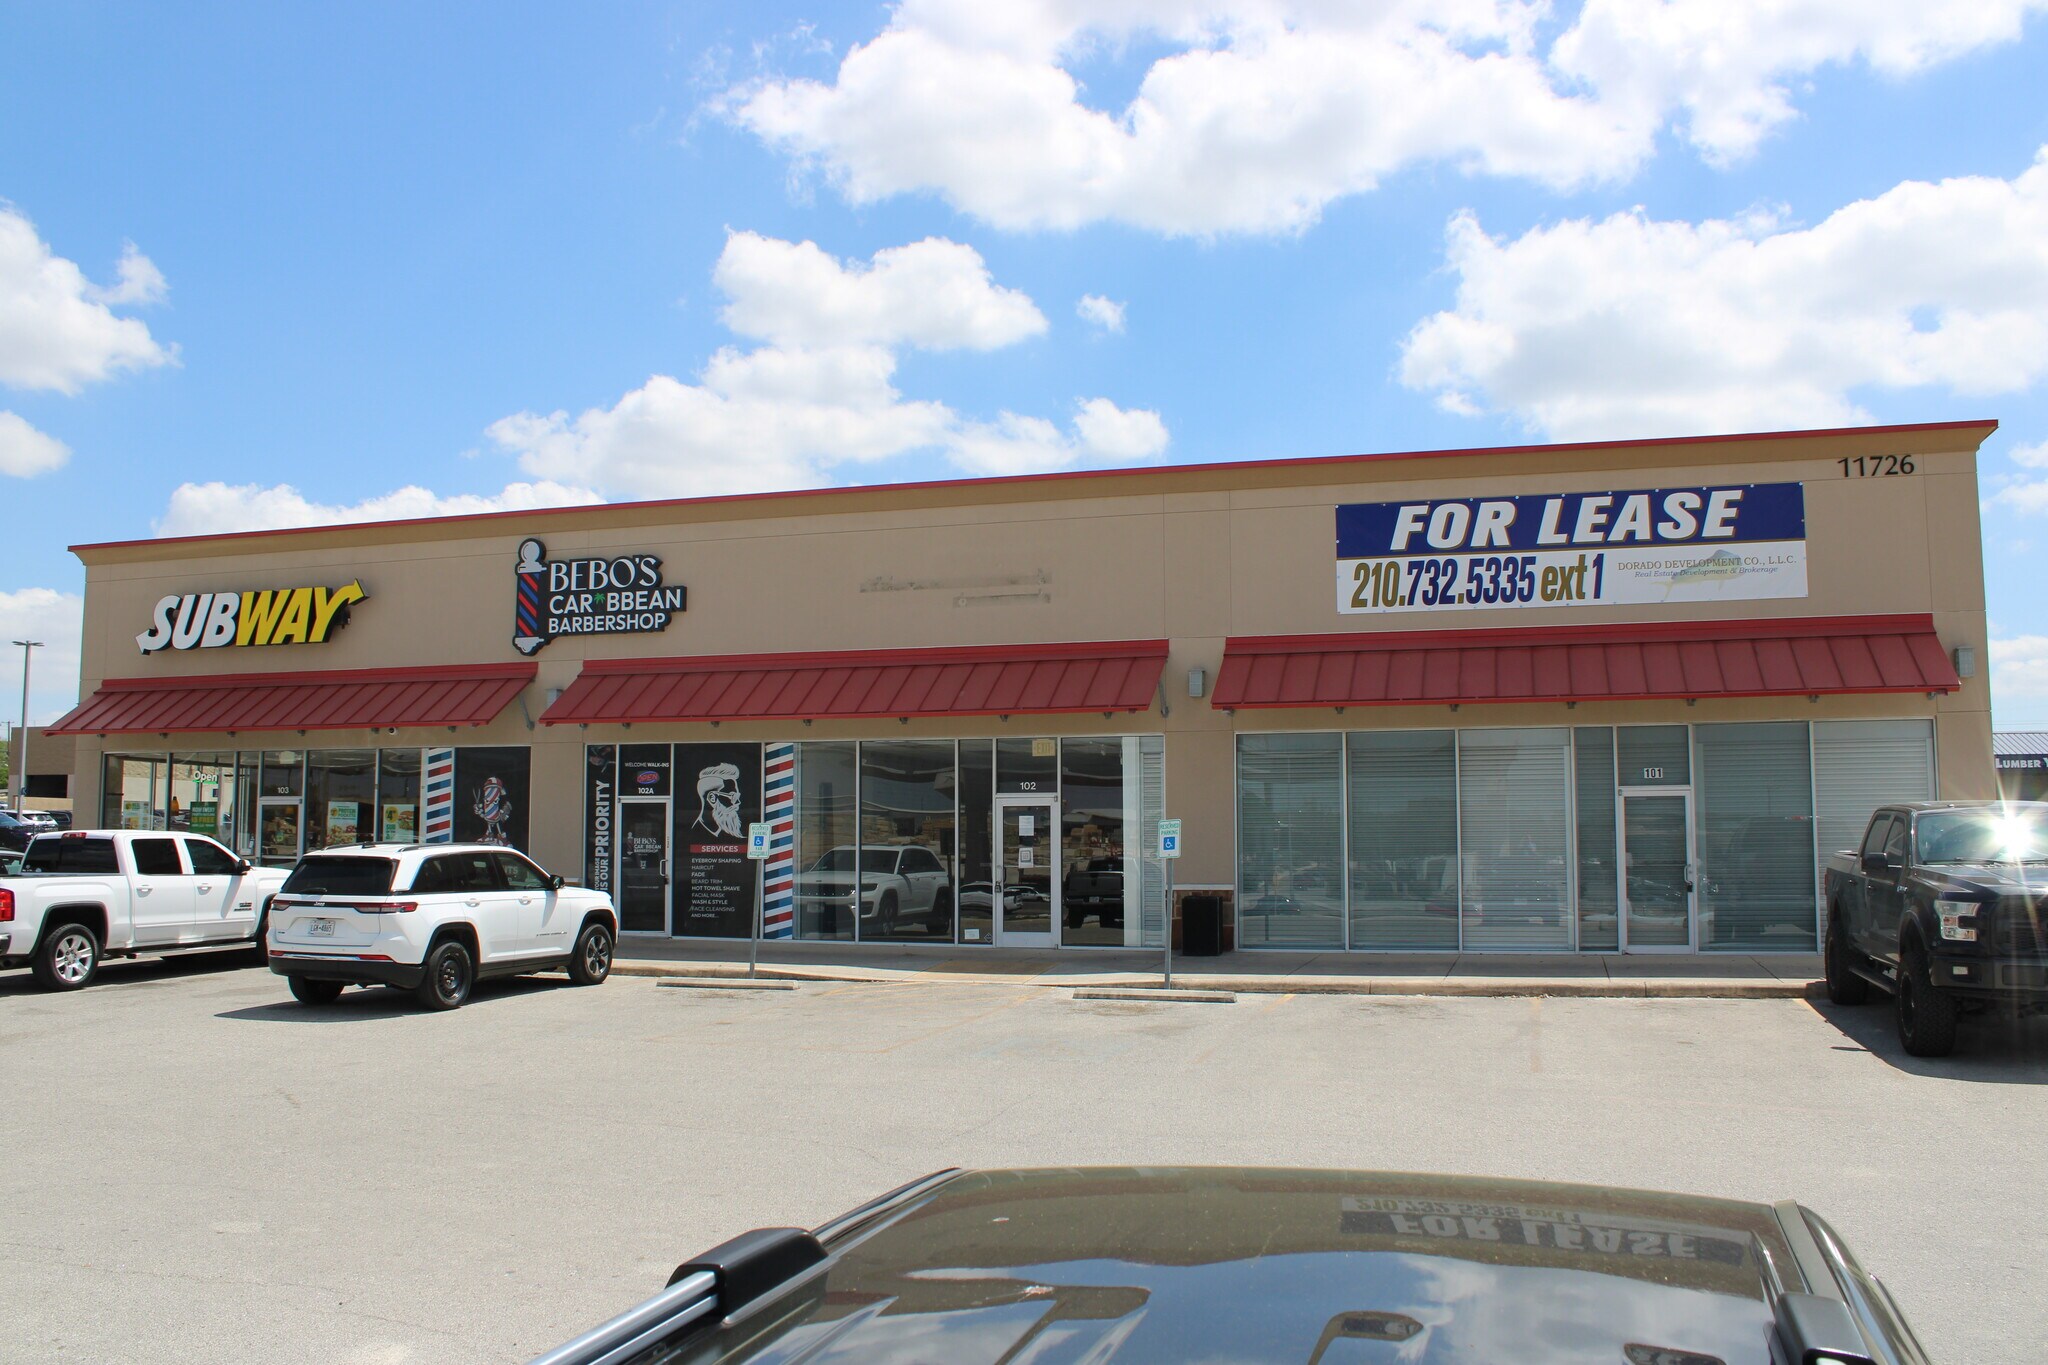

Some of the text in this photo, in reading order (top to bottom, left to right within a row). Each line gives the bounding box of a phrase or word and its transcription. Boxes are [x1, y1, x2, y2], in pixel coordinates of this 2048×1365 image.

[1837, 454, 1915, 477] 11726
[1390, 489, 1743, 550] FOR LEASE
[1618, 555, 1797, 570] DORADO DEVELOPMENT CO., L.L.C.
[550, 557, 658, 592] BEBO'S
[1351, 553, 1605, 608] 210.732.5335 ext 1
[1634, 570, 1652, 578] Real
[1654, 569, 1678, 578] Estate
[1679, 567, 1728, 577] Development
[1738, 566, 1778, 575] Brokerage
[135, 578, 367, 654] SUBWAY
[548, 612, 666, 634] BARBERSHOP
[193, 770, 218, 782] Open
[637, 772, 658, 782] OPEN
[1645, 768, 1662, 778] 101
[277, 786, 290, 794] 103
[1020, 782, 1036, 790] 102
[595, 780, 610, 857] PRIORITY
[701, 845, 739, 853] SERVICES
[600, 859, 609, 880] OUR
